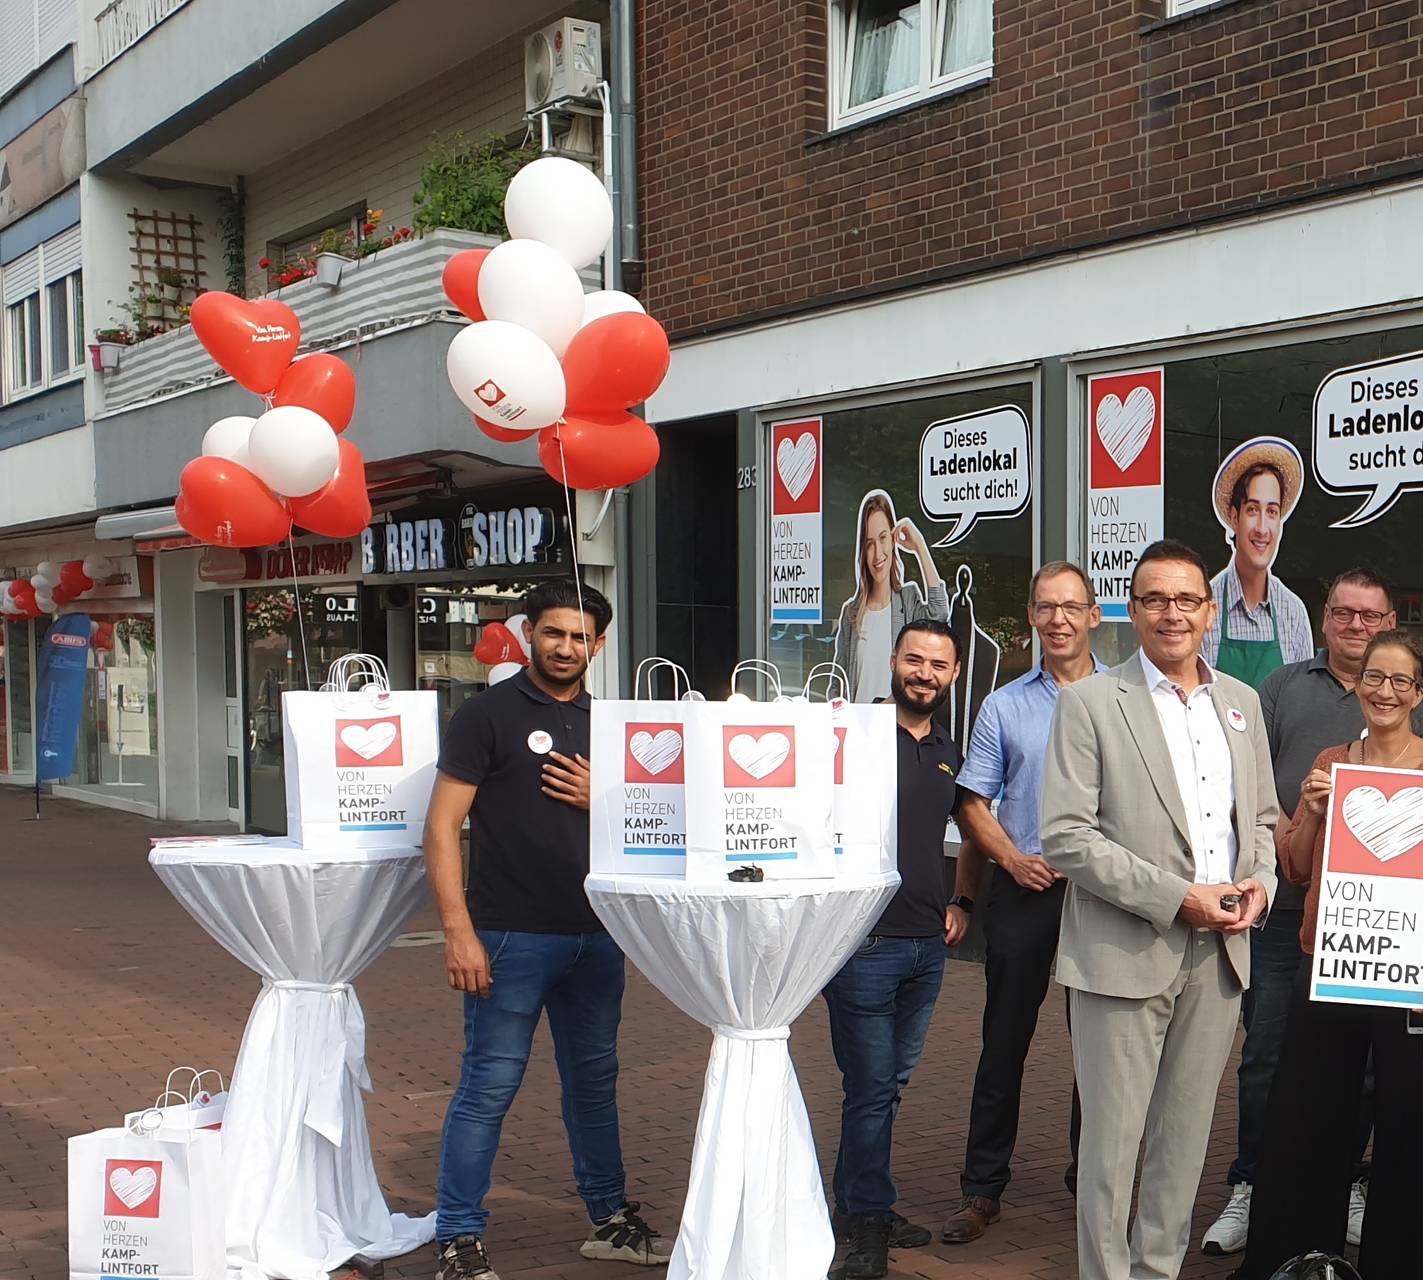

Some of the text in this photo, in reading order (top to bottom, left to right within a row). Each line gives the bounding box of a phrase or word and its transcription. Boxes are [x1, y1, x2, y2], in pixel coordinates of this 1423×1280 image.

[1350, 376, 1419, 404] Dieses
[943, 430, 988, 449] Dieses
[930, 448, 1017, 476] Ladenlokal
[1348, 443, 1406, 471] sucht
[943, 480, 1019, 503] sucht dich!
[1090, 496, 1119, 518] VON
[773, 521, 793, 539] VON
[1091, 522, 1147, 544] HERZEN
[361, 507, 541, 574] BRBER SHOP
[773, 542, 812, 561] HERZEN
[1091, 550, 1139, 571] KAMP-
[773, 565, 806, 583] KAMP-
[773, 587, 821, 604] LINTFORT
[336, 770, 364, 782] VON
[337, 783, 392, 796] HERZEN
[624, 788, 650, 800] VON
[338, 798, 385, 809] KAMP-
[724, 792, 755, 805] VON
[339, 810, 406, 823] LINTFORT
[624, 803, 676, 815] HERZEN
[725, 807, 782, 820] HERZEN
[624, 818, 669, 830] KAMP-
[725, 823, 775, 836] KAMP-
[624, 833, 686, 845] LINTFORT
[726, 837, 798, 851] LINTFORT
[1326, 879, 1373, 902] VON
[1323, 906, 1416, 932] HERZEN
[1321, 932, 1401, 955] KAMP-
[103, 1220, 126, 1231] VON
[103, 1233, 148, 1247] HERZEN
[102, 1248, 141, 1260] KAMP-
[101, 1262, 159, 1275] LINTFORT
